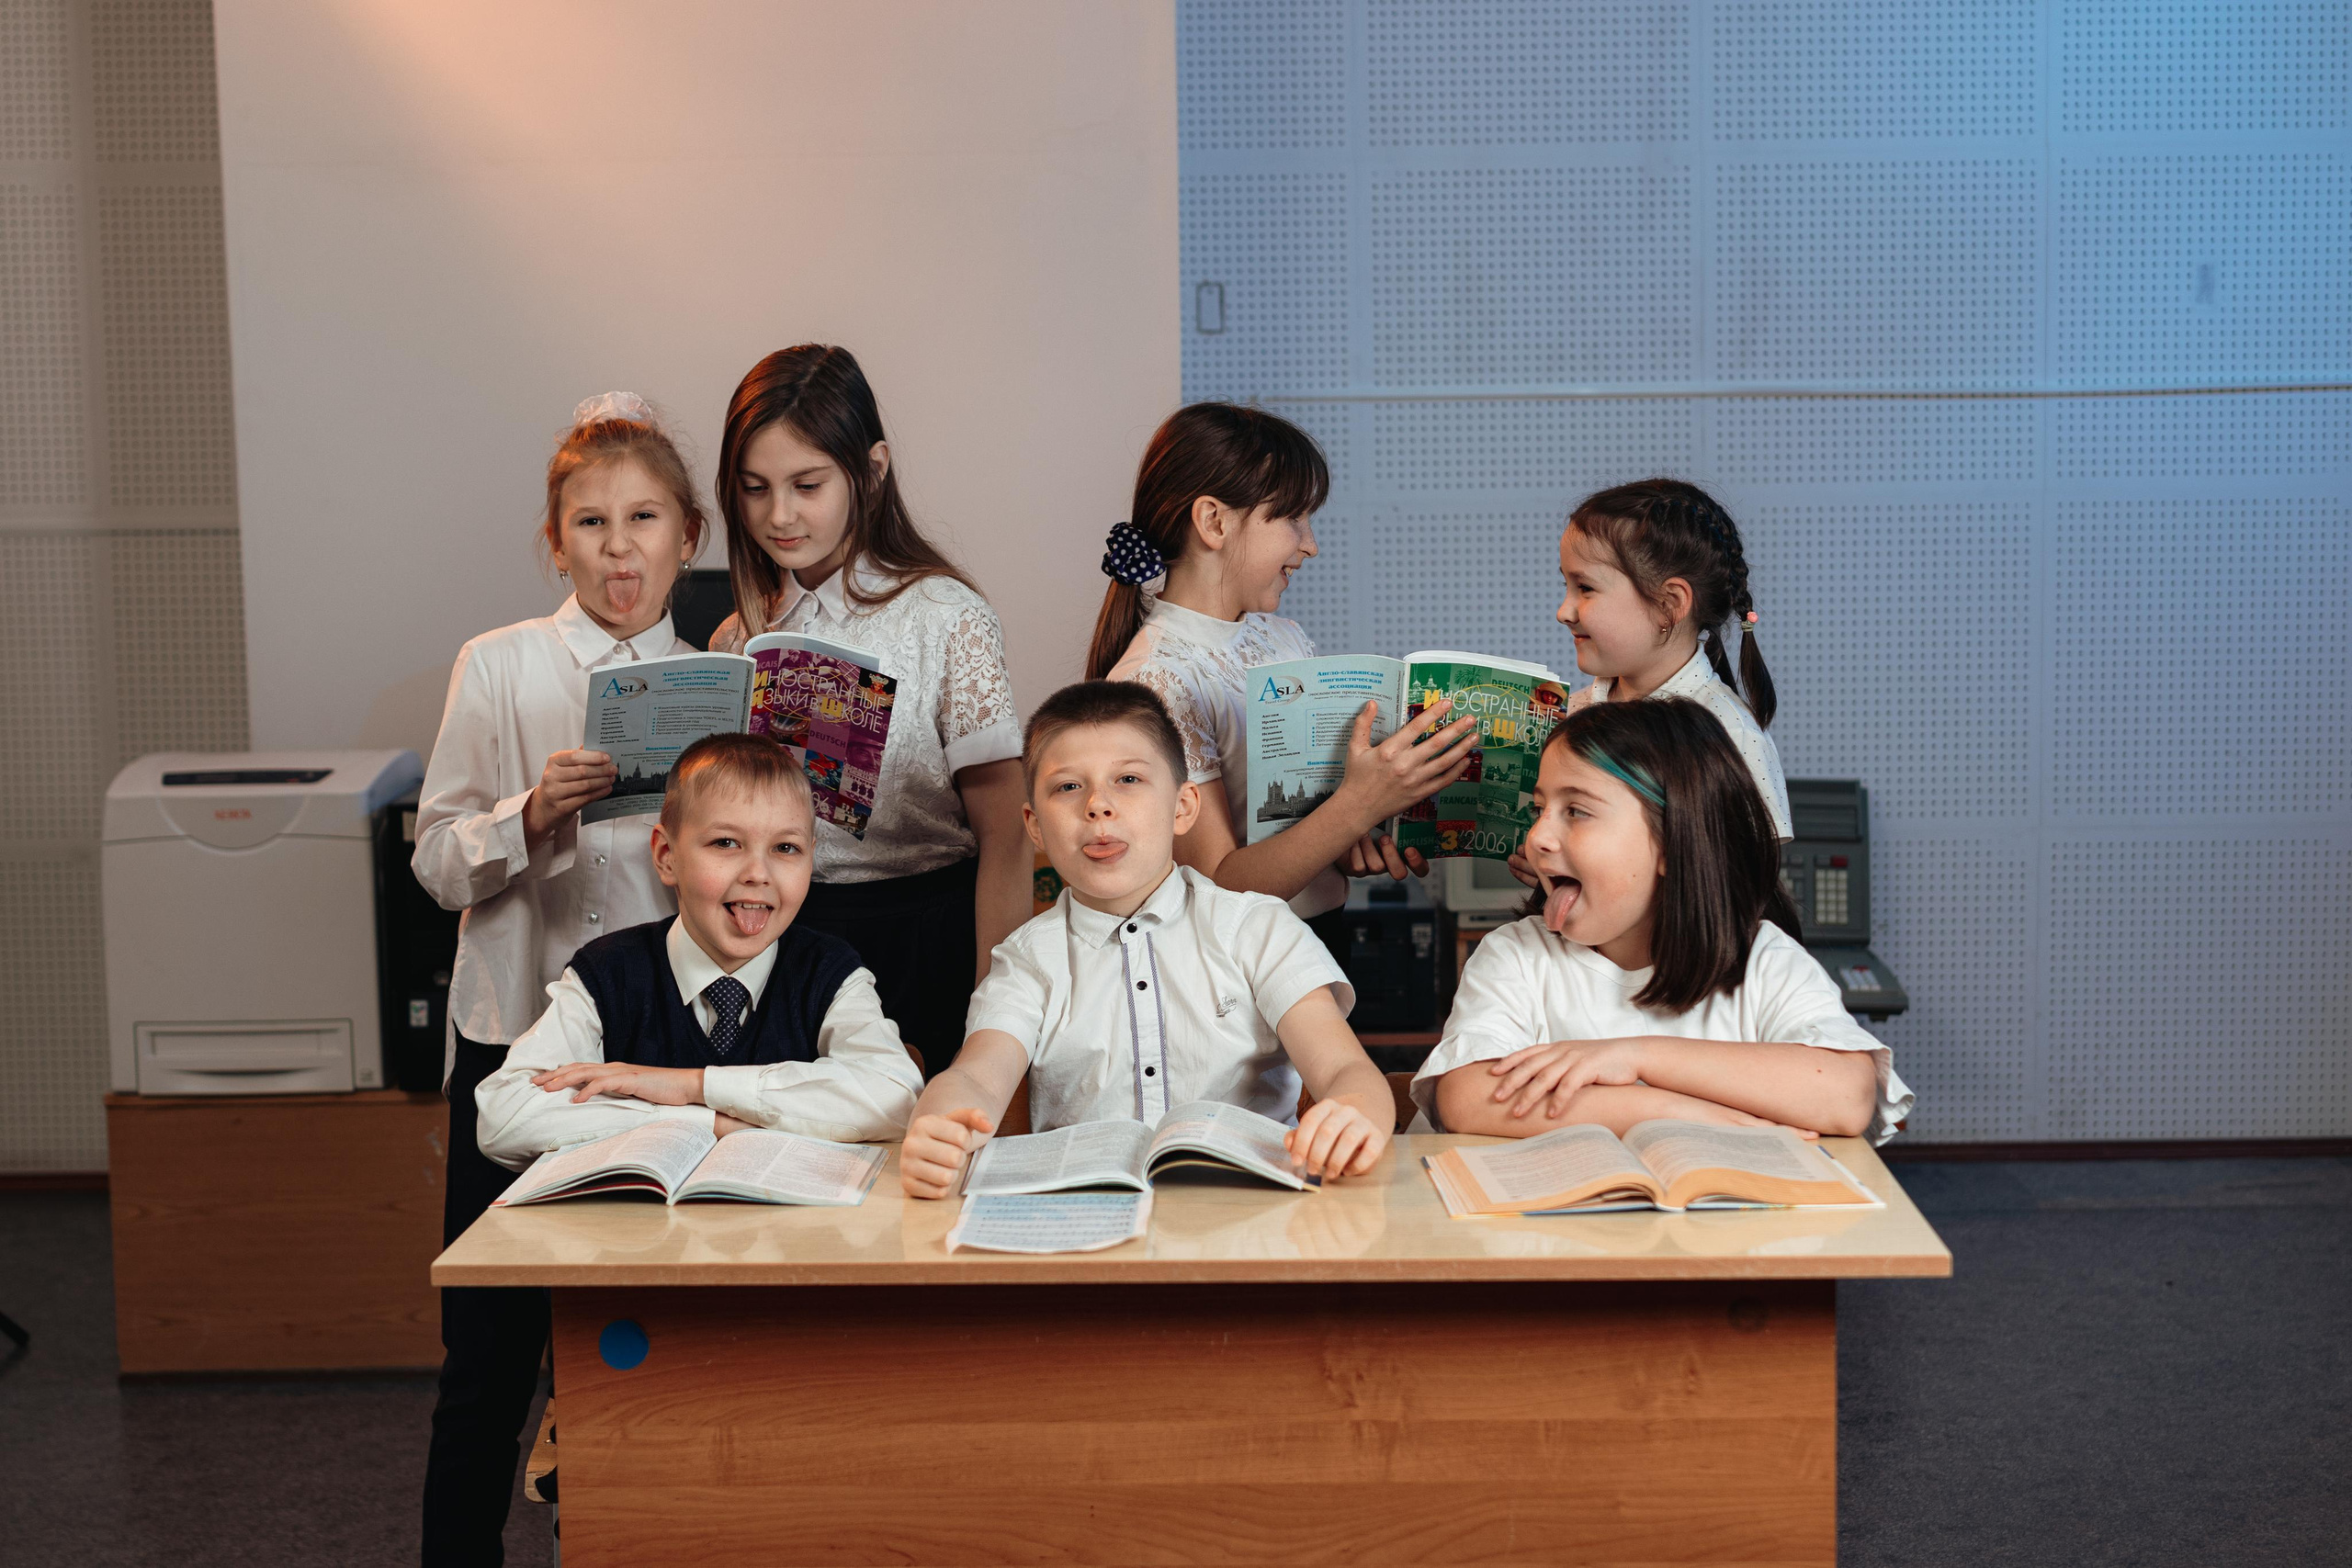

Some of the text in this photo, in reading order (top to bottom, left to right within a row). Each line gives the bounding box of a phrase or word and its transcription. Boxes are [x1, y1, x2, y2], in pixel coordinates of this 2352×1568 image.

[1492, 678, 1531, 694] DEUTSCH
[1493, 718, 1548, 746] ШКОЛ
[1521, 767, 1538, 779] ITAL
[1398, 836, 1435, 848] ENGLISH
